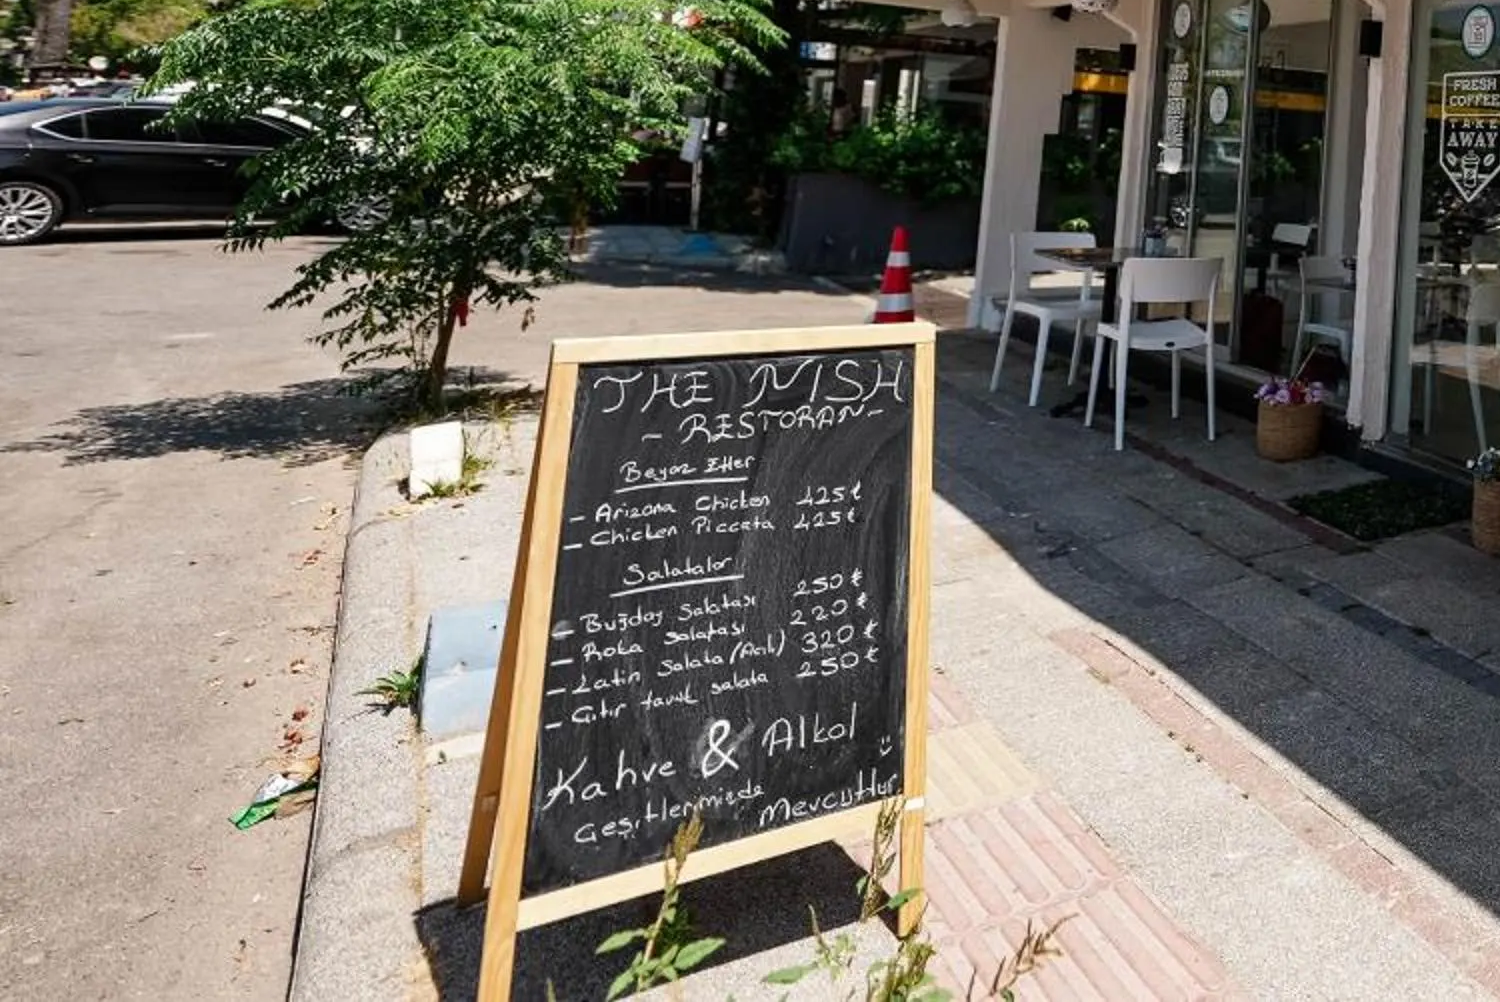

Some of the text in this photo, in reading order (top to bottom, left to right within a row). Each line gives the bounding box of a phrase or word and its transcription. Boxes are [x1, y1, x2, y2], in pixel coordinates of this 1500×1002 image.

[1454, 78, 1497, 91] FRESH
[1450, 93, 1500, 107] COFFEE
[1449, 118, 1498, 129] TAKE
[1447, 131, 1498, 148] AWAY
[594, 370, 713, 413] THE
[620, 461, 697, 483] Beyaz
[595, 502, 677, 524] Arizona
[695, 489, 770, 512] Chicken
[590, 523, 679, 546] Chicken
[581, 639, 645, 662] Roka
[571, 668, 641, 695] Latin
[541, 701, 857, 812] Kahve & Alkol
